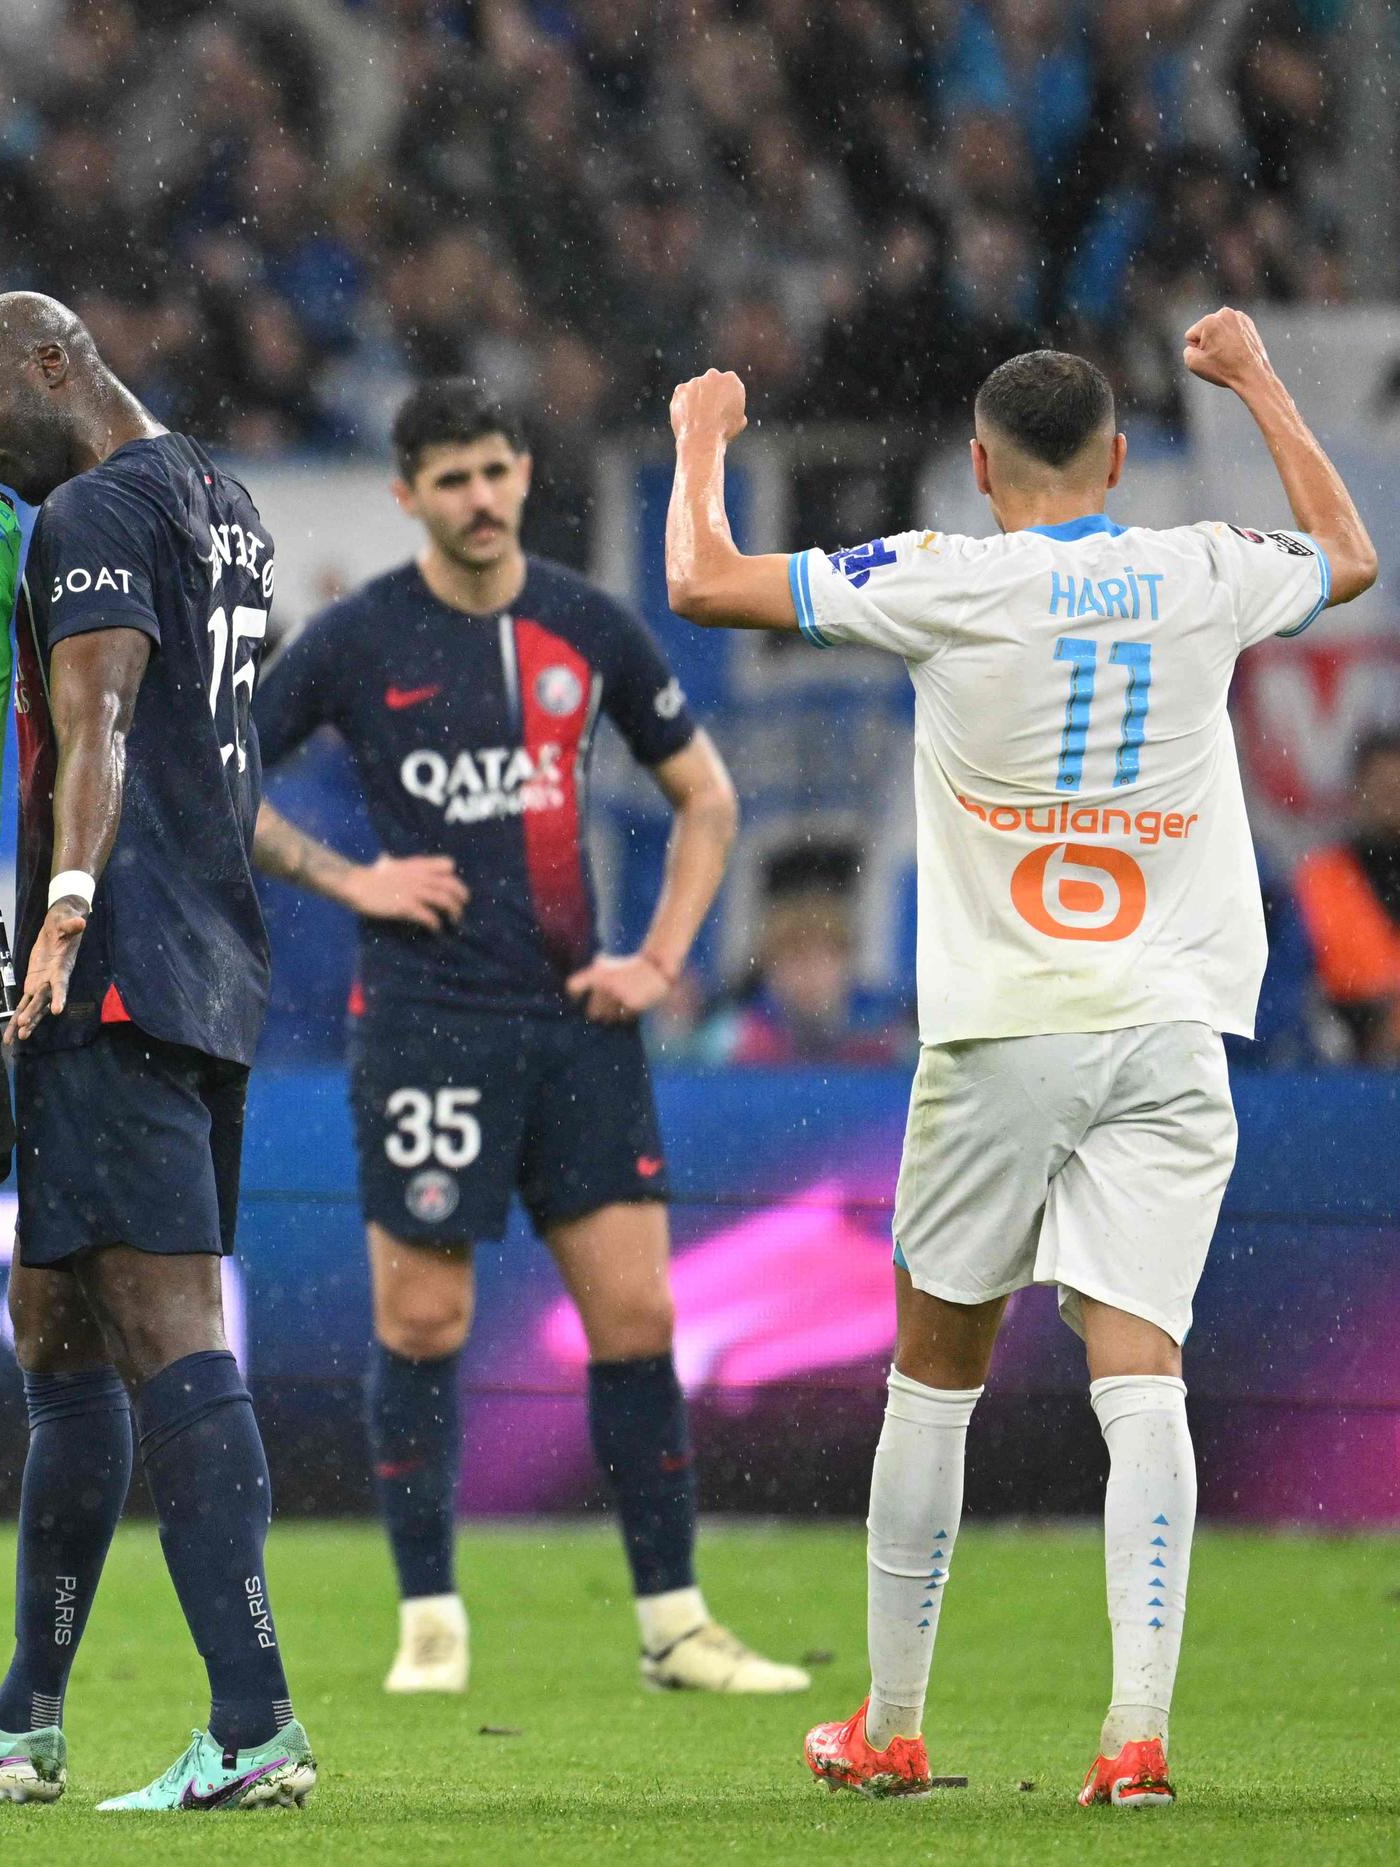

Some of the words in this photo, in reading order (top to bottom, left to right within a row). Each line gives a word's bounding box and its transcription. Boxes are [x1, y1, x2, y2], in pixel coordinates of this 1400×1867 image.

[51, 566, 133, 603] GOAT
[206, 604, 268, 774] 15
[1052, 636, 1153, 792] 11
[400, 741, 564, 807] QATAR
[383, 1086, 483, 1169] 35
[55, 1575, 77, 1647] PARIS
[244, 1575, 277, 1648] PARIS
